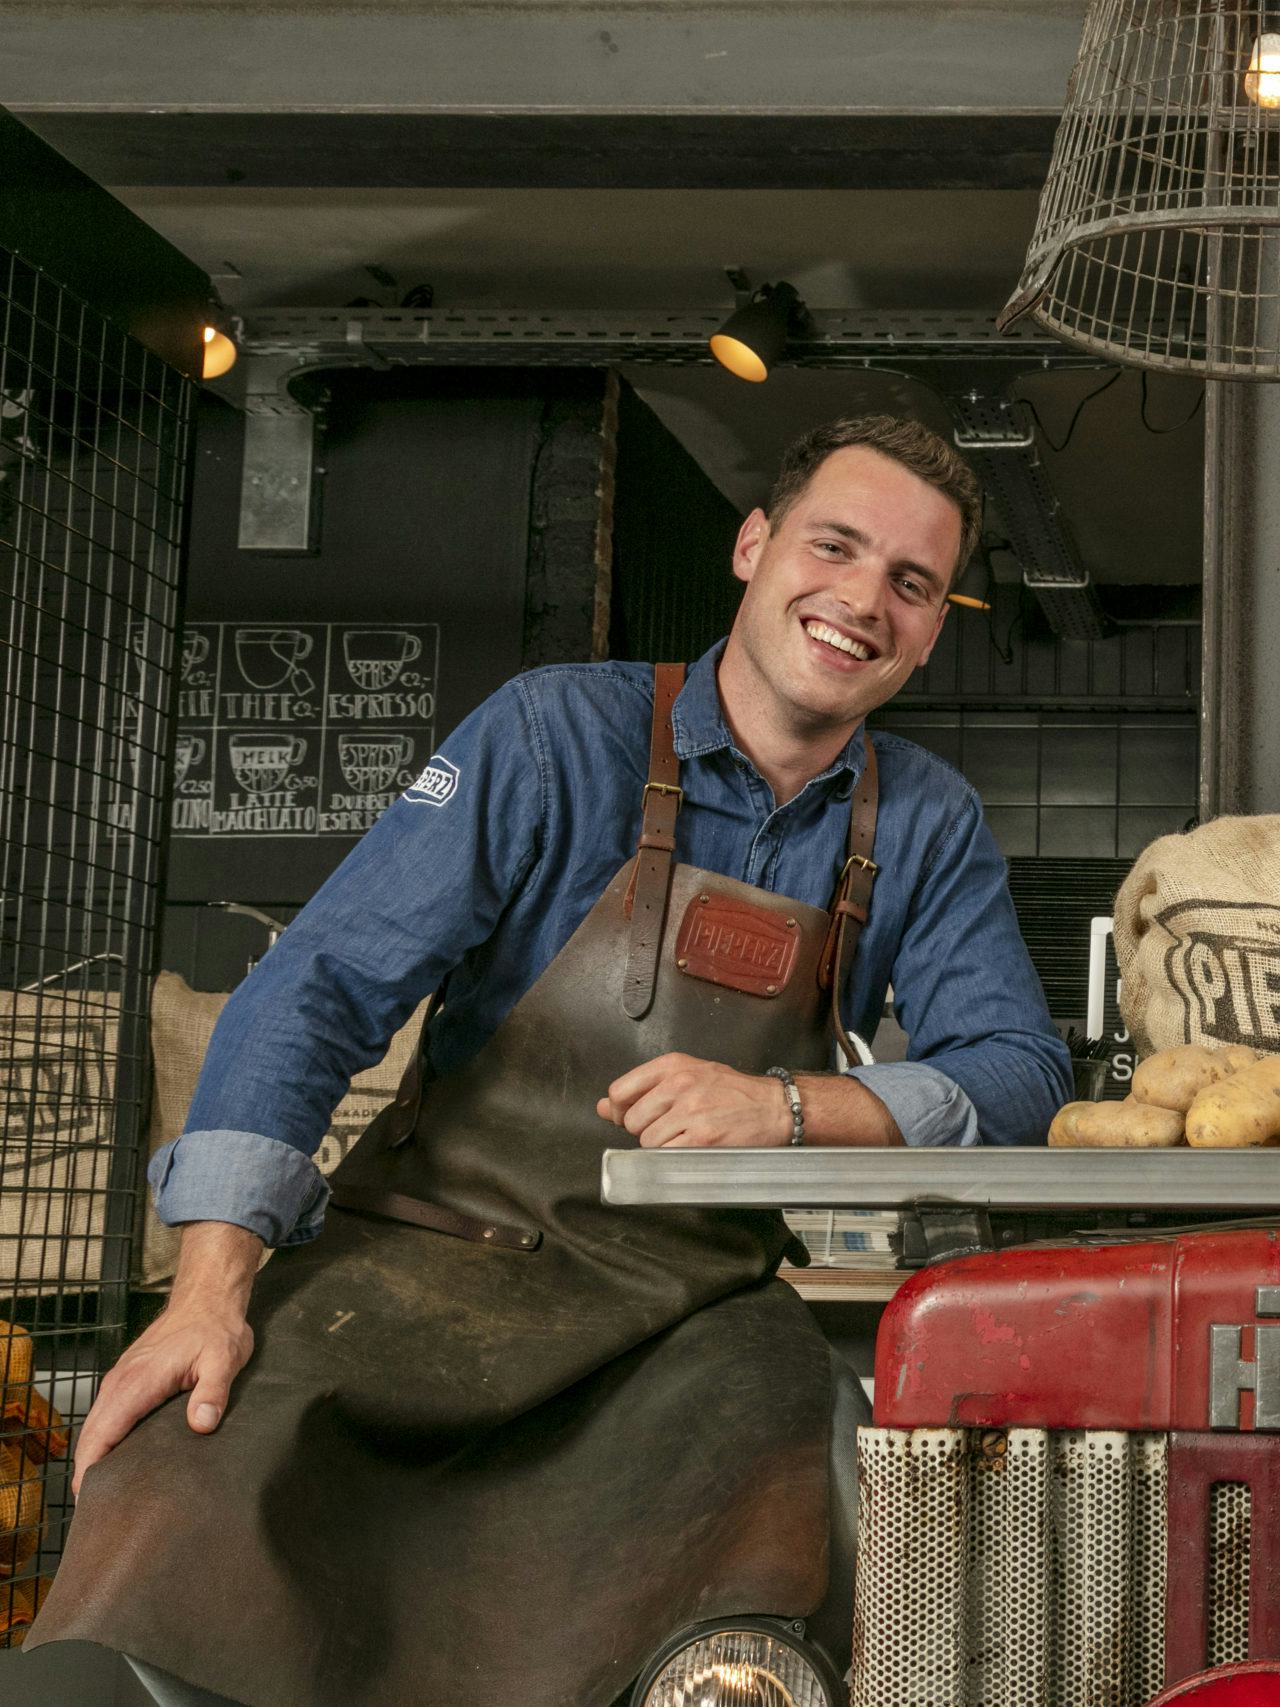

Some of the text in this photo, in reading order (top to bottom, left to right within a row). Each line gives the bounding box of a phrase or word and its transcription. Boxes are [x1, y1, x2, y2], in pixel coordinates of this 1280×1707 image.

[221, 693, 296, 721] THEE
[328, 693, 434, 719] ESPRESSO
[229, 791, 298, 811] LATTE
[694, 921, 779, 967] PIEPERZ
